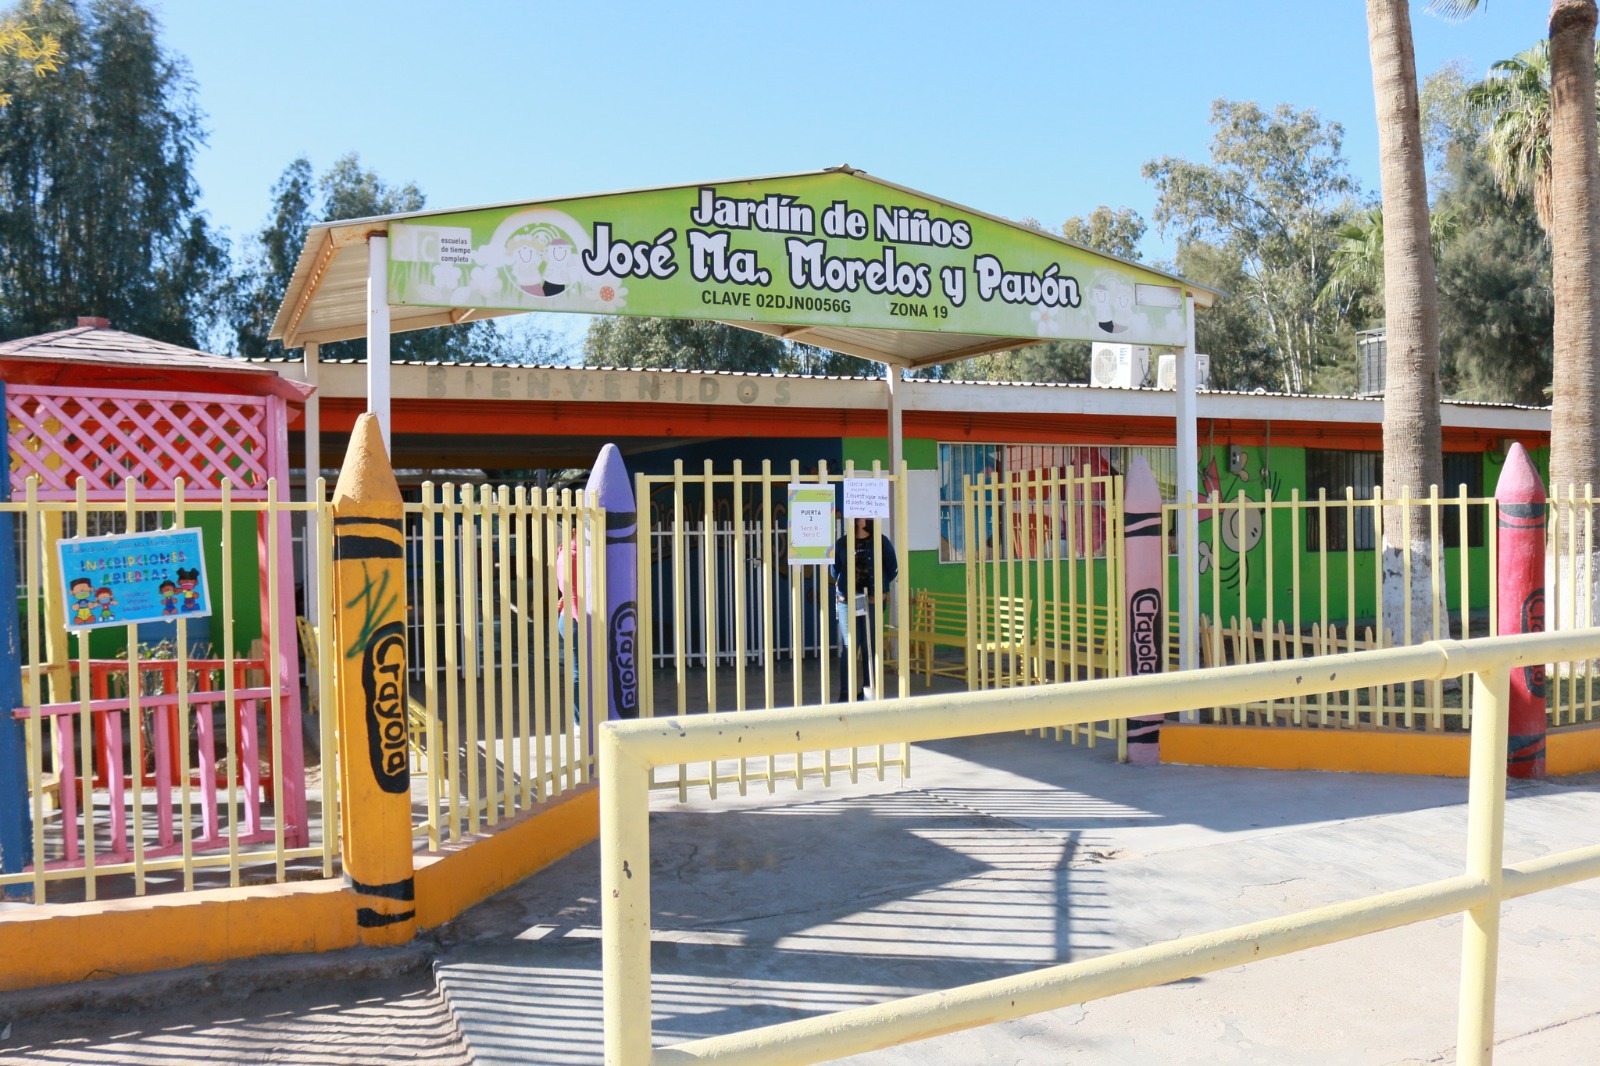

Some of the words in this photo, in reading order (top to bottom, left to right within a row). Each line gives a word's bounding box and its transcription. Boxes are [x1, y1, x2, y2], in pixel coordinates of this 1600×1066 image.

[691, 188, 815, 235] Jardín
[821, 200, 868, 240] de
[874, 204, 972, 249] Niños
[441, 237, 468, 245] escuelas
[450, 246, 471, 255] tiempo
[441, 255, 469, 263] completo
[582, 222, 678, 280] José
[686, 229, 772, 286] Ma.
[785, 238, 931, 297] Morelos
[940, 265, 966, 307] y
[974, 254, 1080, 307] Pavón
[702, 290, 751, 306] CLAVE
[756, 294, 851, 313] 02DJN0056G
[889, 302, 928, 317] ZONA
[933, 305, 948, 318] 19
[427, 366, 791, 405] BIENVENIDOS
[80, 551, 186, 572] INSCRIPCIONES
[102, 568, 169, 585] ABIERTAS
[1134, 594, 1158, 675] Crayola
[615, 610, 638, 708] Crayola
[375, 634, 406, 776] Crayola
